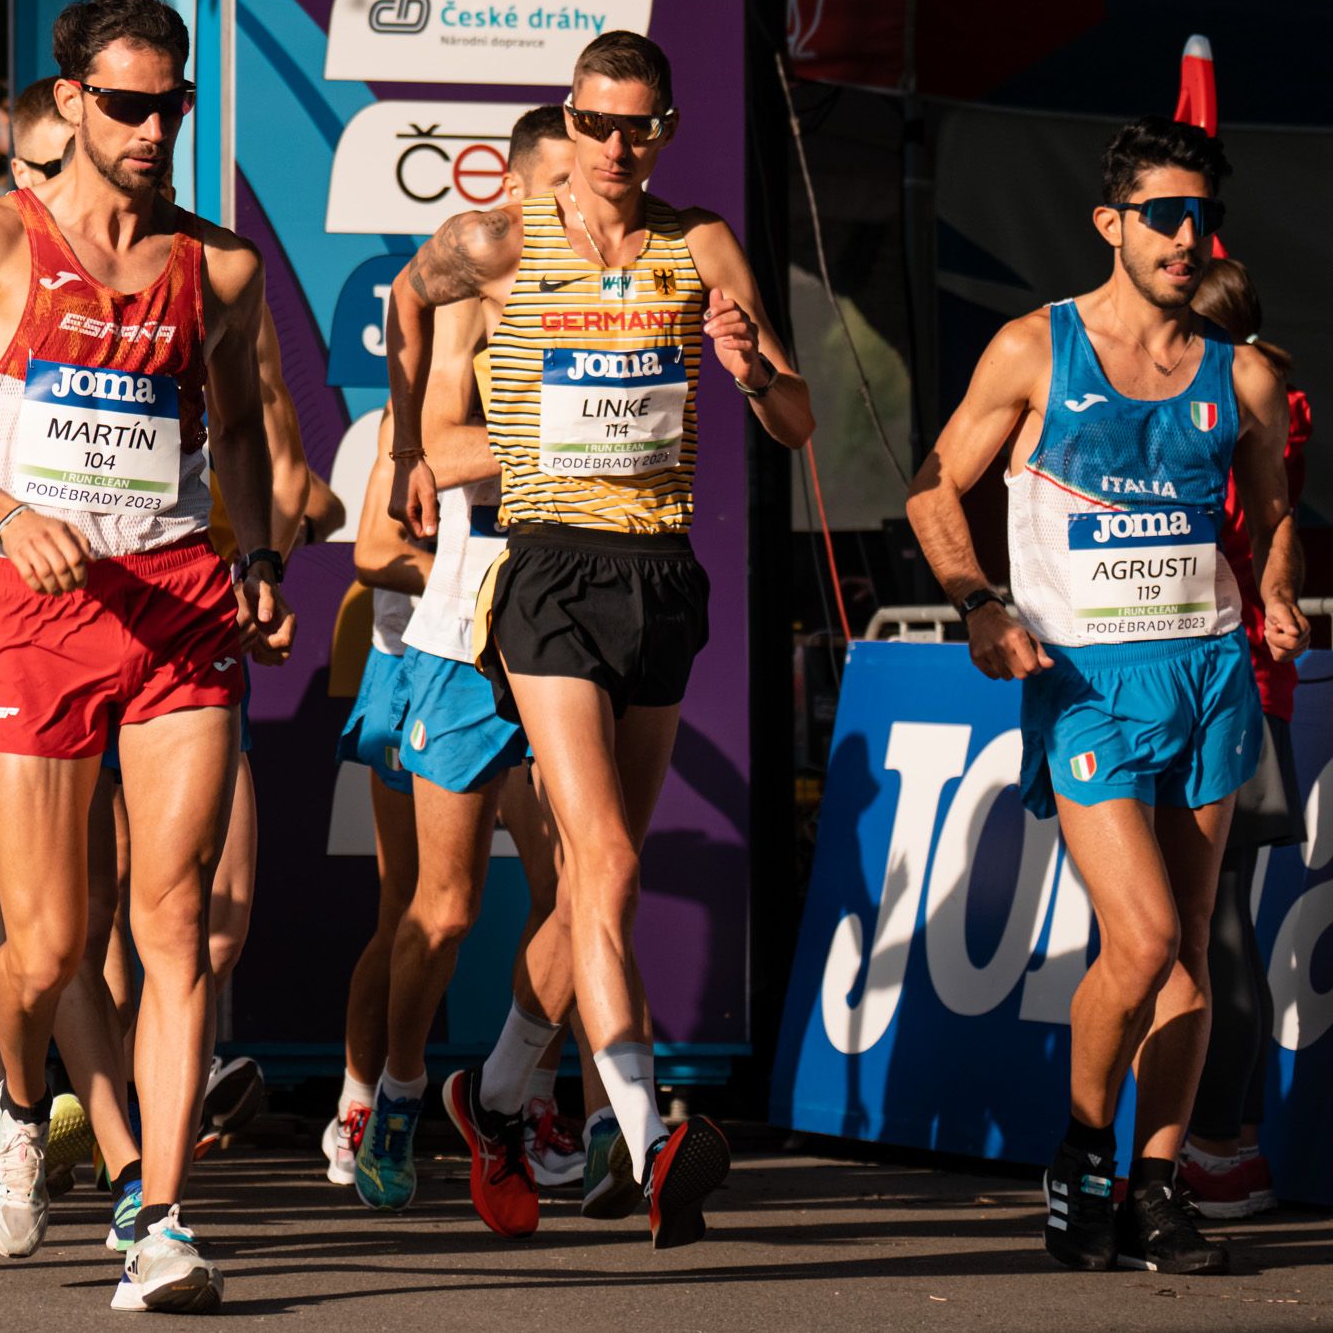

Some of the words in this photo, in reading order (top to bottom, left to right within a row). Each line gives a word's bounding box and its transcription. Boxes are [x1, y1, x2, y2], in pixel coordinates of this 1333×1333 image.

[440, 1, 518, 30] České
[528, 6, 606, 36] dráhy
[542, 310, 681, 332] GERMANY
[583, 398, 651, 417] LINKE
[47, 417, 156, 450] MARTÍN
[605, 423, 629, 438] 114
[590, 444, 614, 453] RUN
[614, 443, 645, 452] CLEAN
[84, 452, 116, 470] 104
[552, 456, 640, 469] PODĚBRADY
[642, 452, 670, 466] 2023
[69, 474, 94, 484] RUN
[94, 477, 130, 488] CLEAN
[1101, 475, 1178, 499] ITALIA
[26, 481, 123, 506] PODĚBRADY
[125, 496, 162, 510] 2023
[1092, 557, 1197, 581] AGRUSTI
[1137, 585, 1161, 600] 119
[1124, 607, 1145, 616] RUN
[1147, 605, 1178, 614] CLEAN
[1087, 619, 1175, 634] PODĚBRADY
[1177, 618, 1205, 630] 2023
